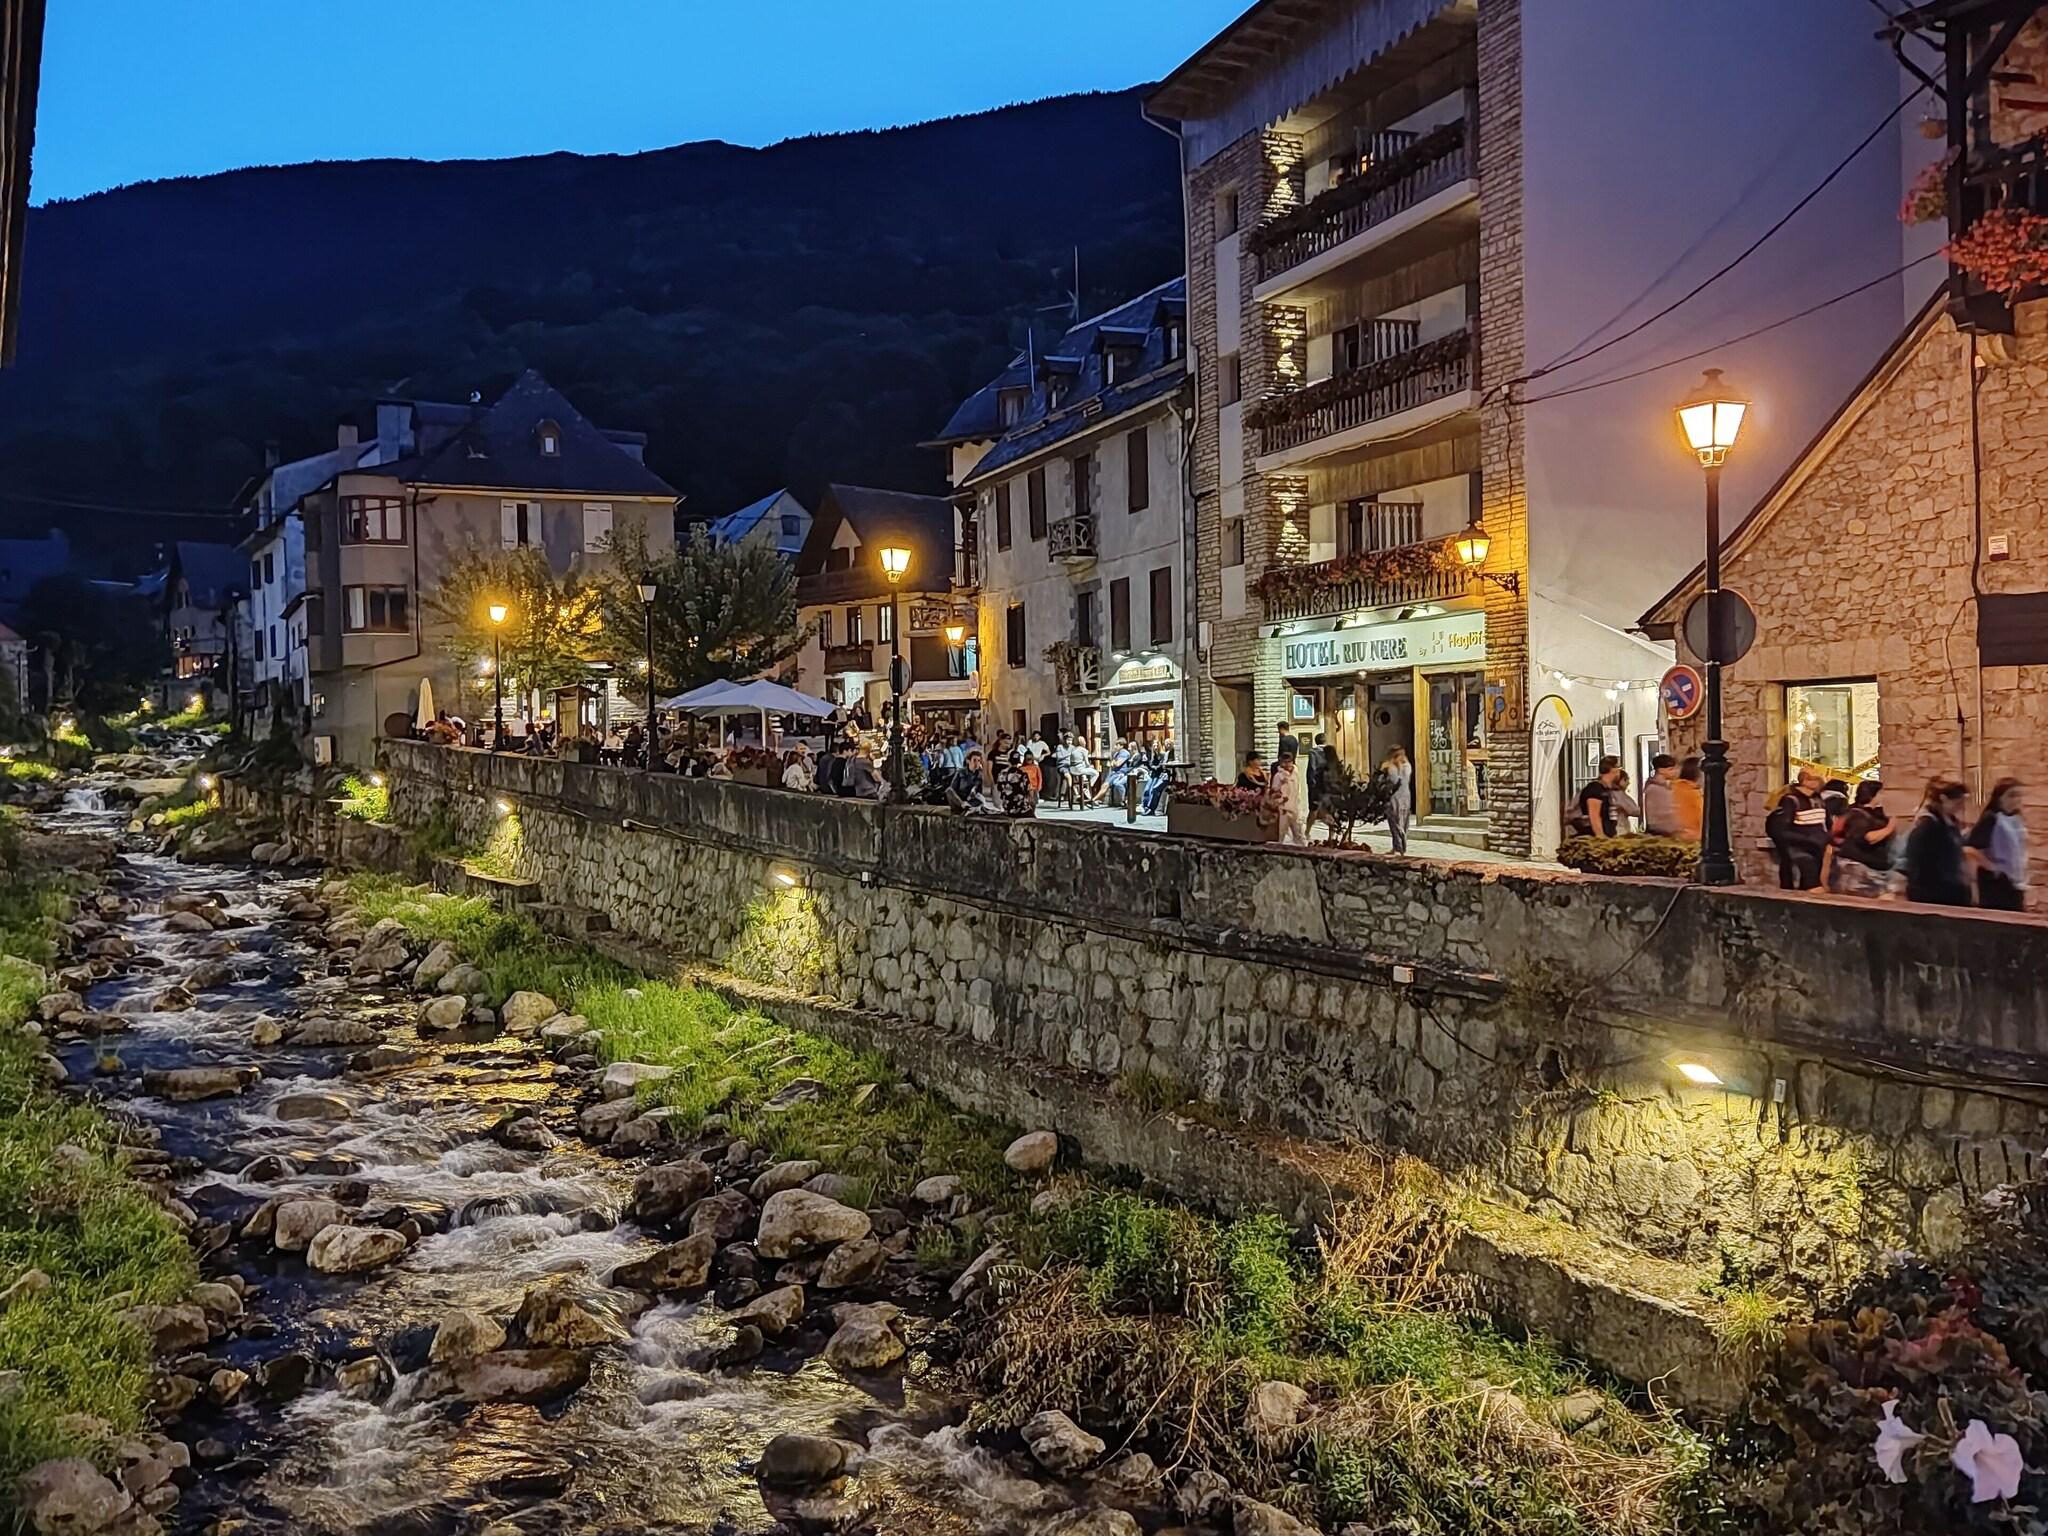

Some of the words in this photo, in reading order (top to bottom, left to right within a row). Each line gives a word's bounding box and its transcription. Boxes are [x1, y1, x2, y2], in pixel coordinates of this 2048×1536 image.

[1449, 630, 1485, 650] Haglöf
[1285, 640, 1340, 670] HOTEL
[1343, 642, 1368, 663] RIU
[1370, 637, 1407, 661] NERE
